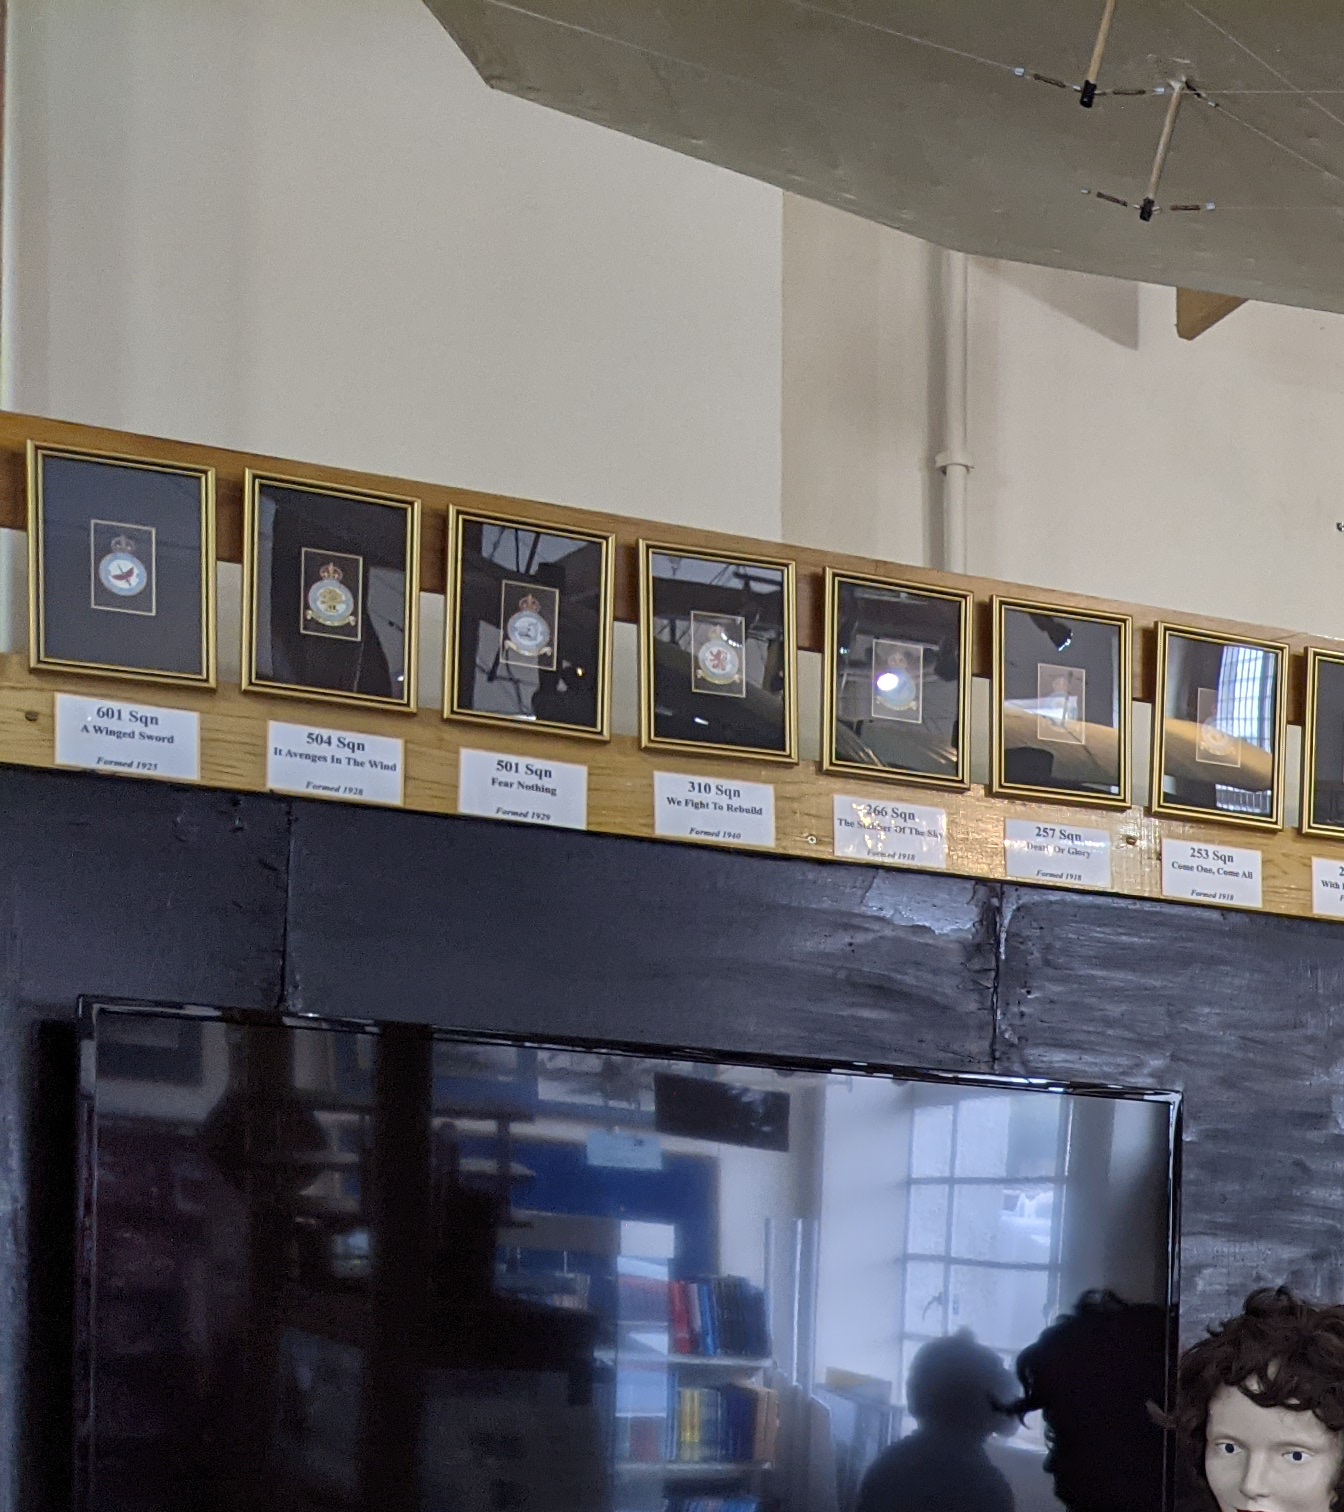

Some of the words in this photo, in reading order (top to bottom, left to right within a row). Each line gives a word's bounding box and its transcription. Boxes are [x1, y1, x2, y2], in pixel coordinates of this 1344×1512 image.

[96, 706, 122, 721] 601
[128, 710, 159, 727] Sqn
[80, 724, 89, 733] A
[92, 725, 135, 740] Winged
[138, 731, 175, 744] Sword
[306, 734, 332, 747] 504
[336, 737, 365, 753] Sqn
[273, 747, 282, 757] It
[285, 749, 327, 763] Avenges
[330, 755, 342, 765] In
[346, 757, 365, 768] The
[368, 760, 397, 772] Wind
[496, 761, 519, 774] 501
[524, 764, 552, 780] Sqn
[491, 778, 513, 789] Fear
[516, 781, 557, 796] Nothing
[688, 782, 711, 795] 310
[715, 785, 741, 800] Sqn
[667, 797, 681, 807] We
[684, 799, 709, 811] Fight
[712, 802, 723, 811] To
[726, 803, 763, 816] Rebuild
[866, 805, 887, 818] 266
[890, 807, 915, 823] Sqn
[1035, 827, 1055, 839] 257
[1058, 829, 1082, 843] Sqn
[1190, 848, 1209, 860] 253
[1212, 850, 1234, 864] Sqn
[1171, 861, 1194, 871] Come
[1195, 864, 1214, 875] One,
[1216, 867, 1239, 877] Come
[1241, 870, 1253, 879] All
[1321, 880, 1340, 889] With
